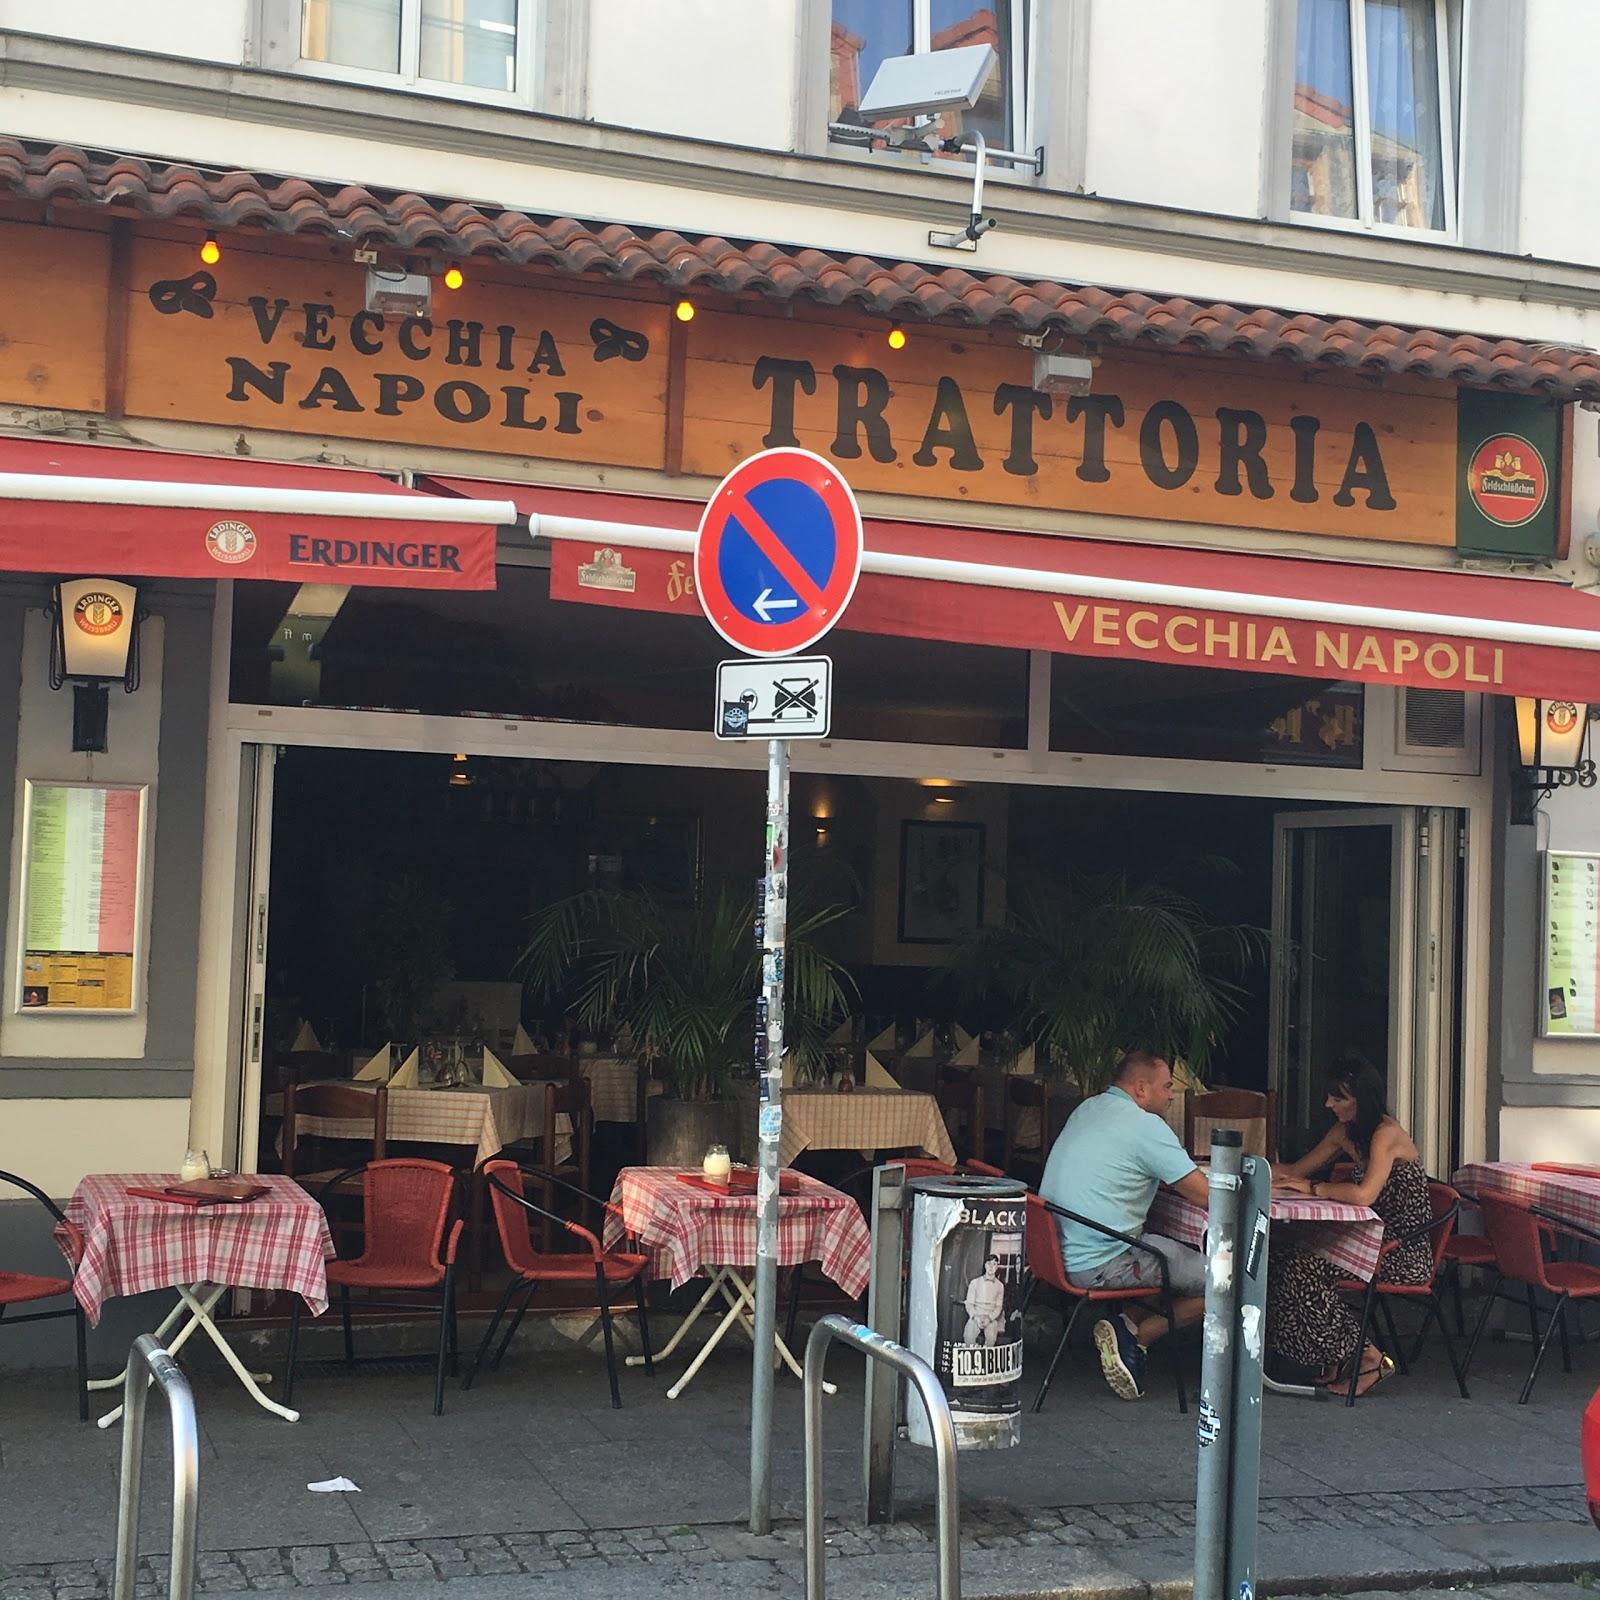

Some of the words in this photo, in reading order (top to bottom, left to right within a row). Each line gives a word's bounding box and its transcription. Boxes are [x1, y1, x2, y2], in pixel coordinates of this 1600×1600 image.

[248, 296, 567, 376] VECCHIA
[224, 356, 584, 434] NAPOLI
[751, 355, 1398, 511] TRATTORIA
[208, 522, 253, 543] ERDINGER
[288, 534, 464, 572] ERDINGER
[77, 594, 120, 613] ERDINGER
[1053, 601, 1298, 664] VECCHIA
[1314, 630, 1503, 684] NAPOLI
[959, 1208, 1017, 1226] BLACK
[958, 1350, 986, 1375] 10.9.
[987, 1347, 1011, 1375] BLUE
